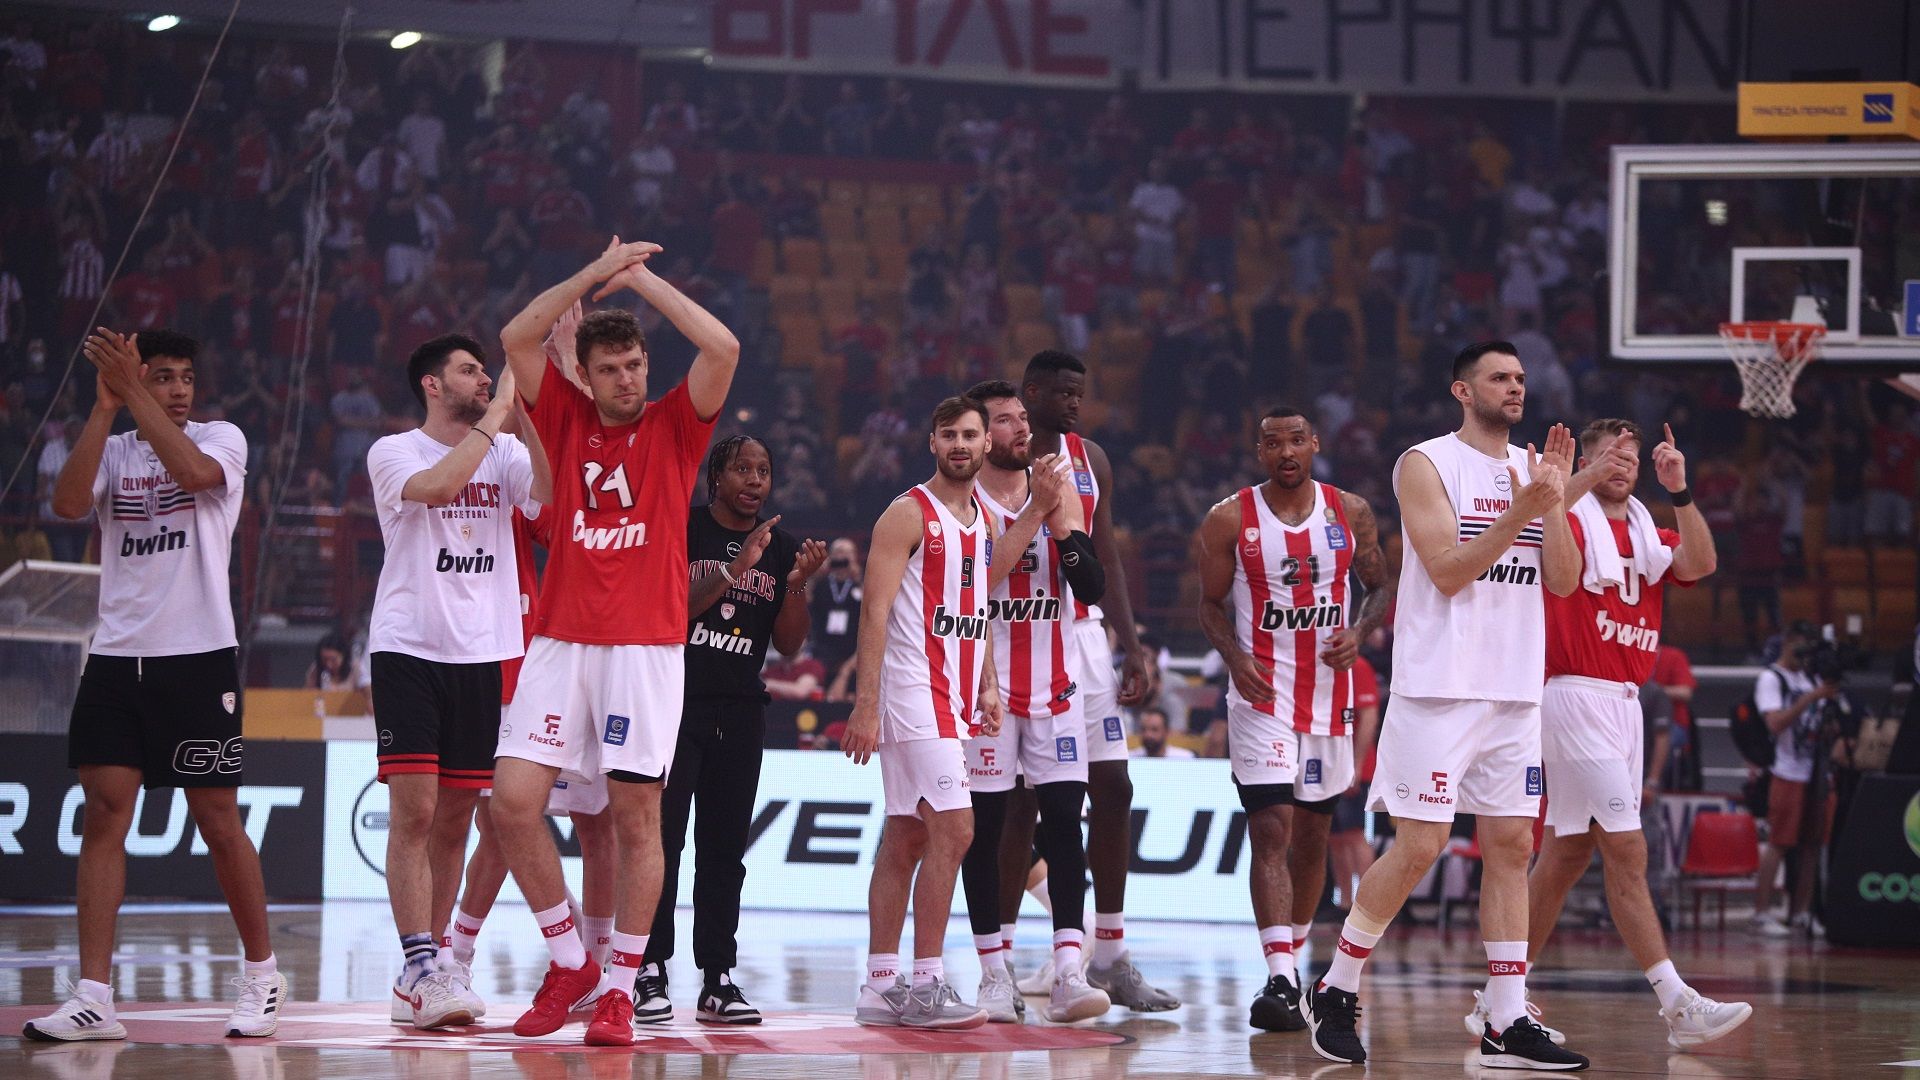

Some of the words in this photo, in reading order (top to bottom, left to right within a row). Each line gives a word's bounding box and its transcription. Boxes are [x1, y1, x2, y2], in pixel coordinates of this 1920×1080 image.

[583, 461, 635, 510] 14
[120, 525, 187, 557] bwin
[572, 509, 646, 550] bwin
[436, 547, 495, 574] bwin
[961, 556, 974, 589] 9
[1280, 554, 1320, 587] 21
[1259, 596, 1342, 631] bwin
[689, 622, 754, 656] bwin
[1595, 609, 1659, 653] bwin
[528, 732, 566, 748] FlexCar
[970, 768, 1003, 776] FlexCar
[546, 921, 573, 936] GSA
[612, 949, 626, 964] SA
[1491, 962, 1520, 973] GSA
[871, 969, 896, 978] GSA
